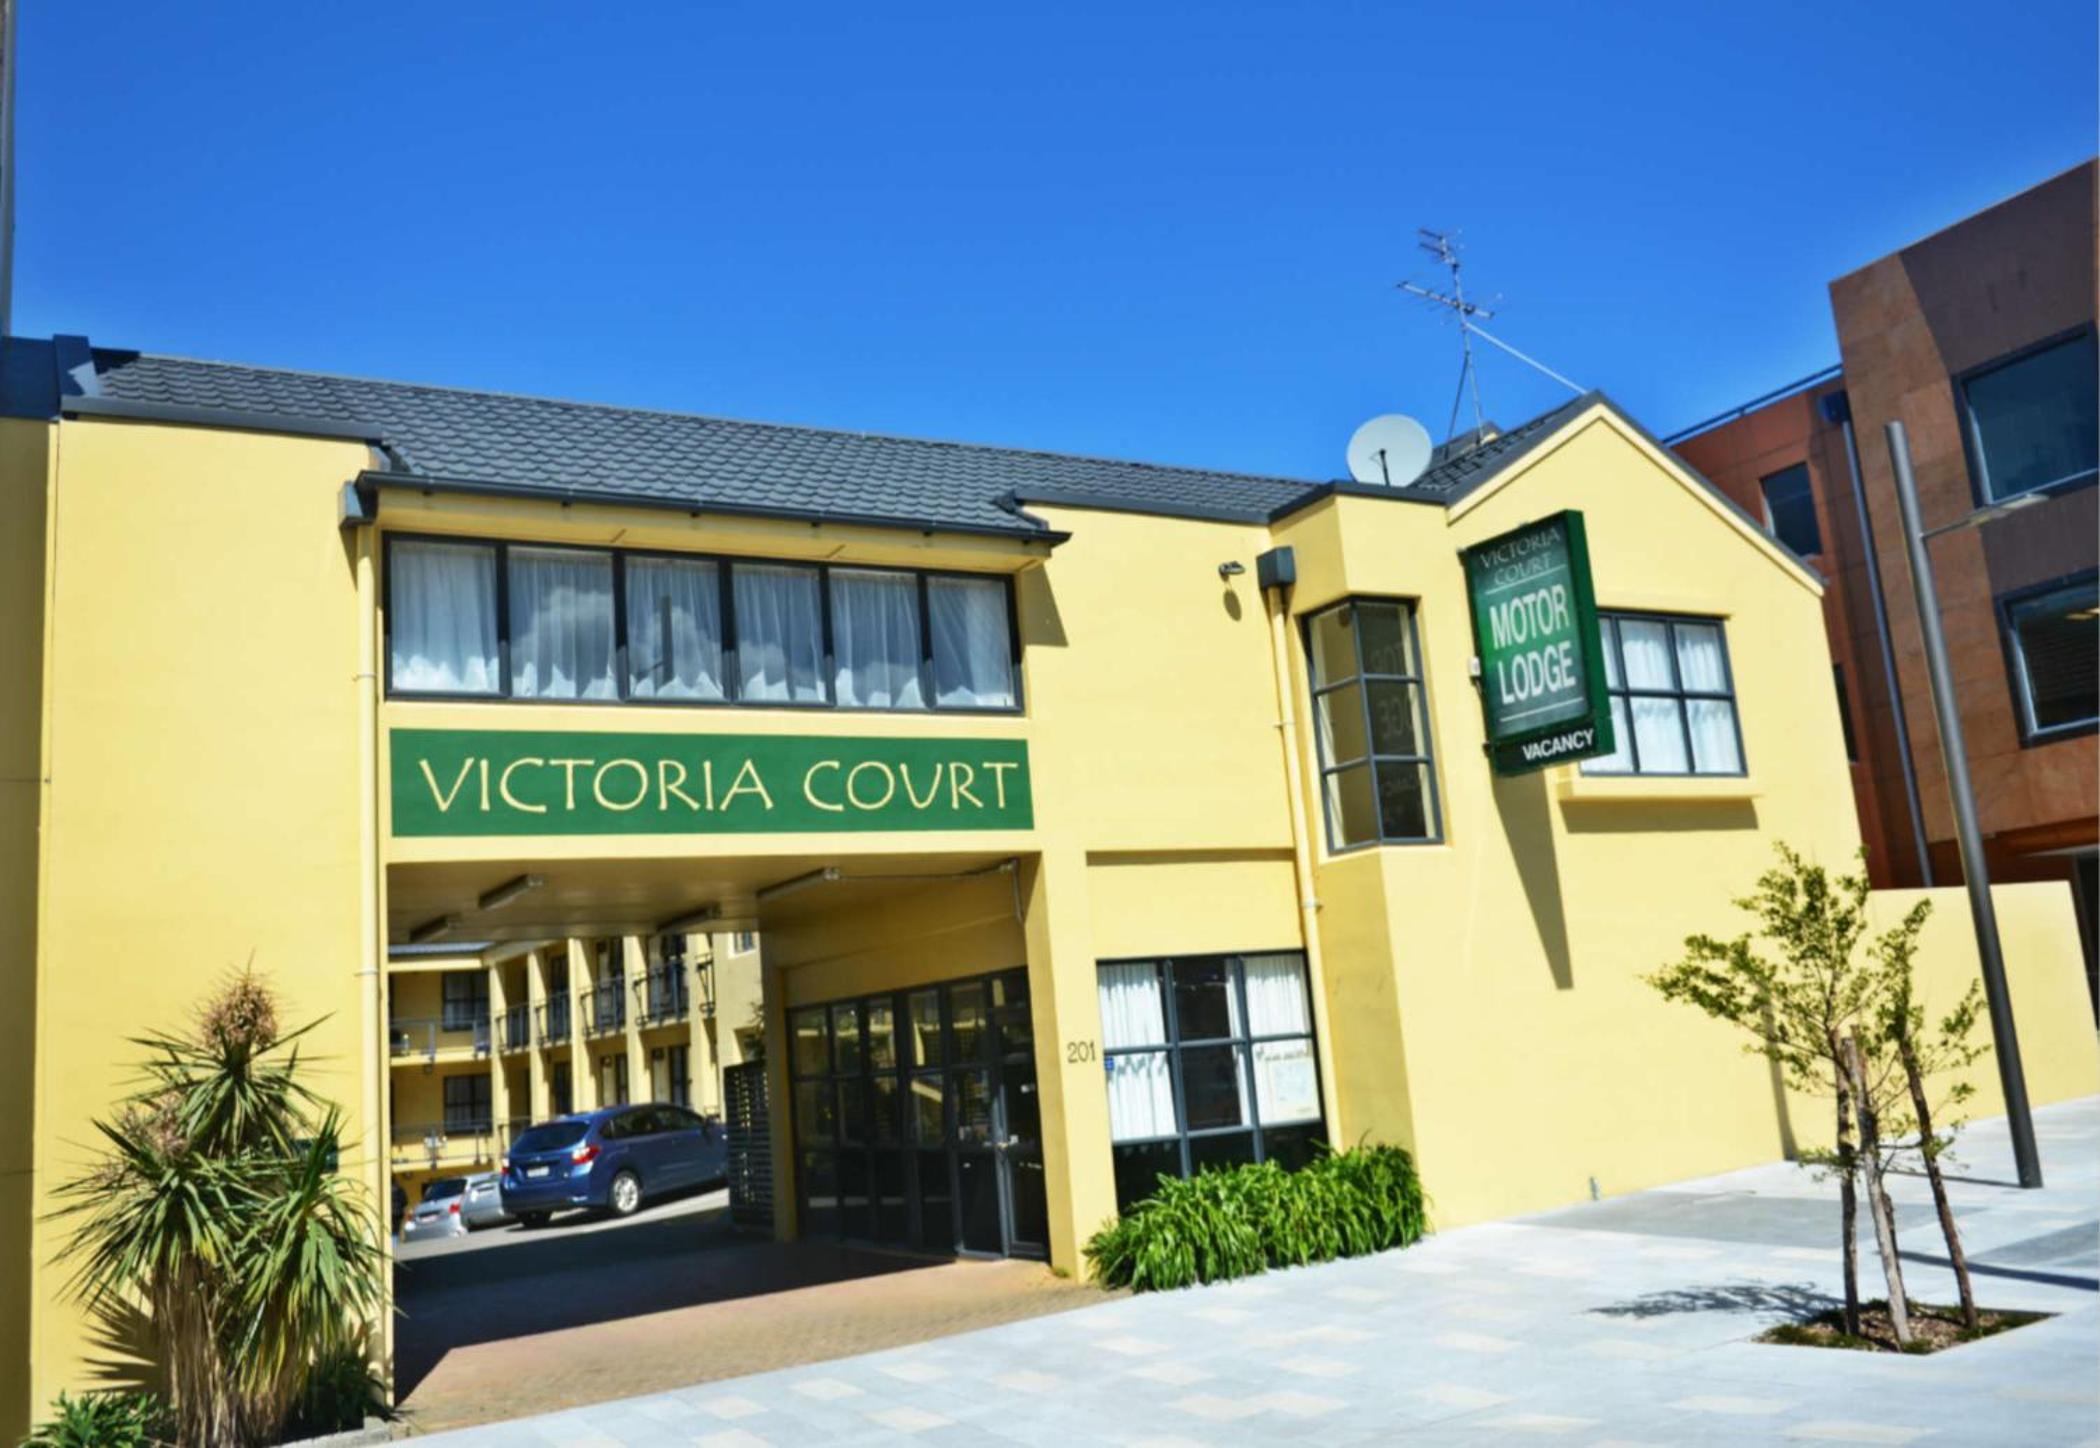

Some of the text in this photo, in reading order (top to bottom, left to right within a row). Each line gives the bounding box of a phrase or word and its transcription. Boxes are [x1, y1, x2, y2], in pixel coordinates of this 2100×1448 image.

[1480, 527, 1560, 569] VICTORIA
[1493, 553, 1551, 586] COURT
[1489, 584, 1570, 650] MOTOR
[1498, 641, 1576, 705] LODGE
[1522, 728, 1594, 760] VACANCY
[419, 757, 1018, 813] VICTORIA COURT
[1067, 1041, 1096, 1064] 201
